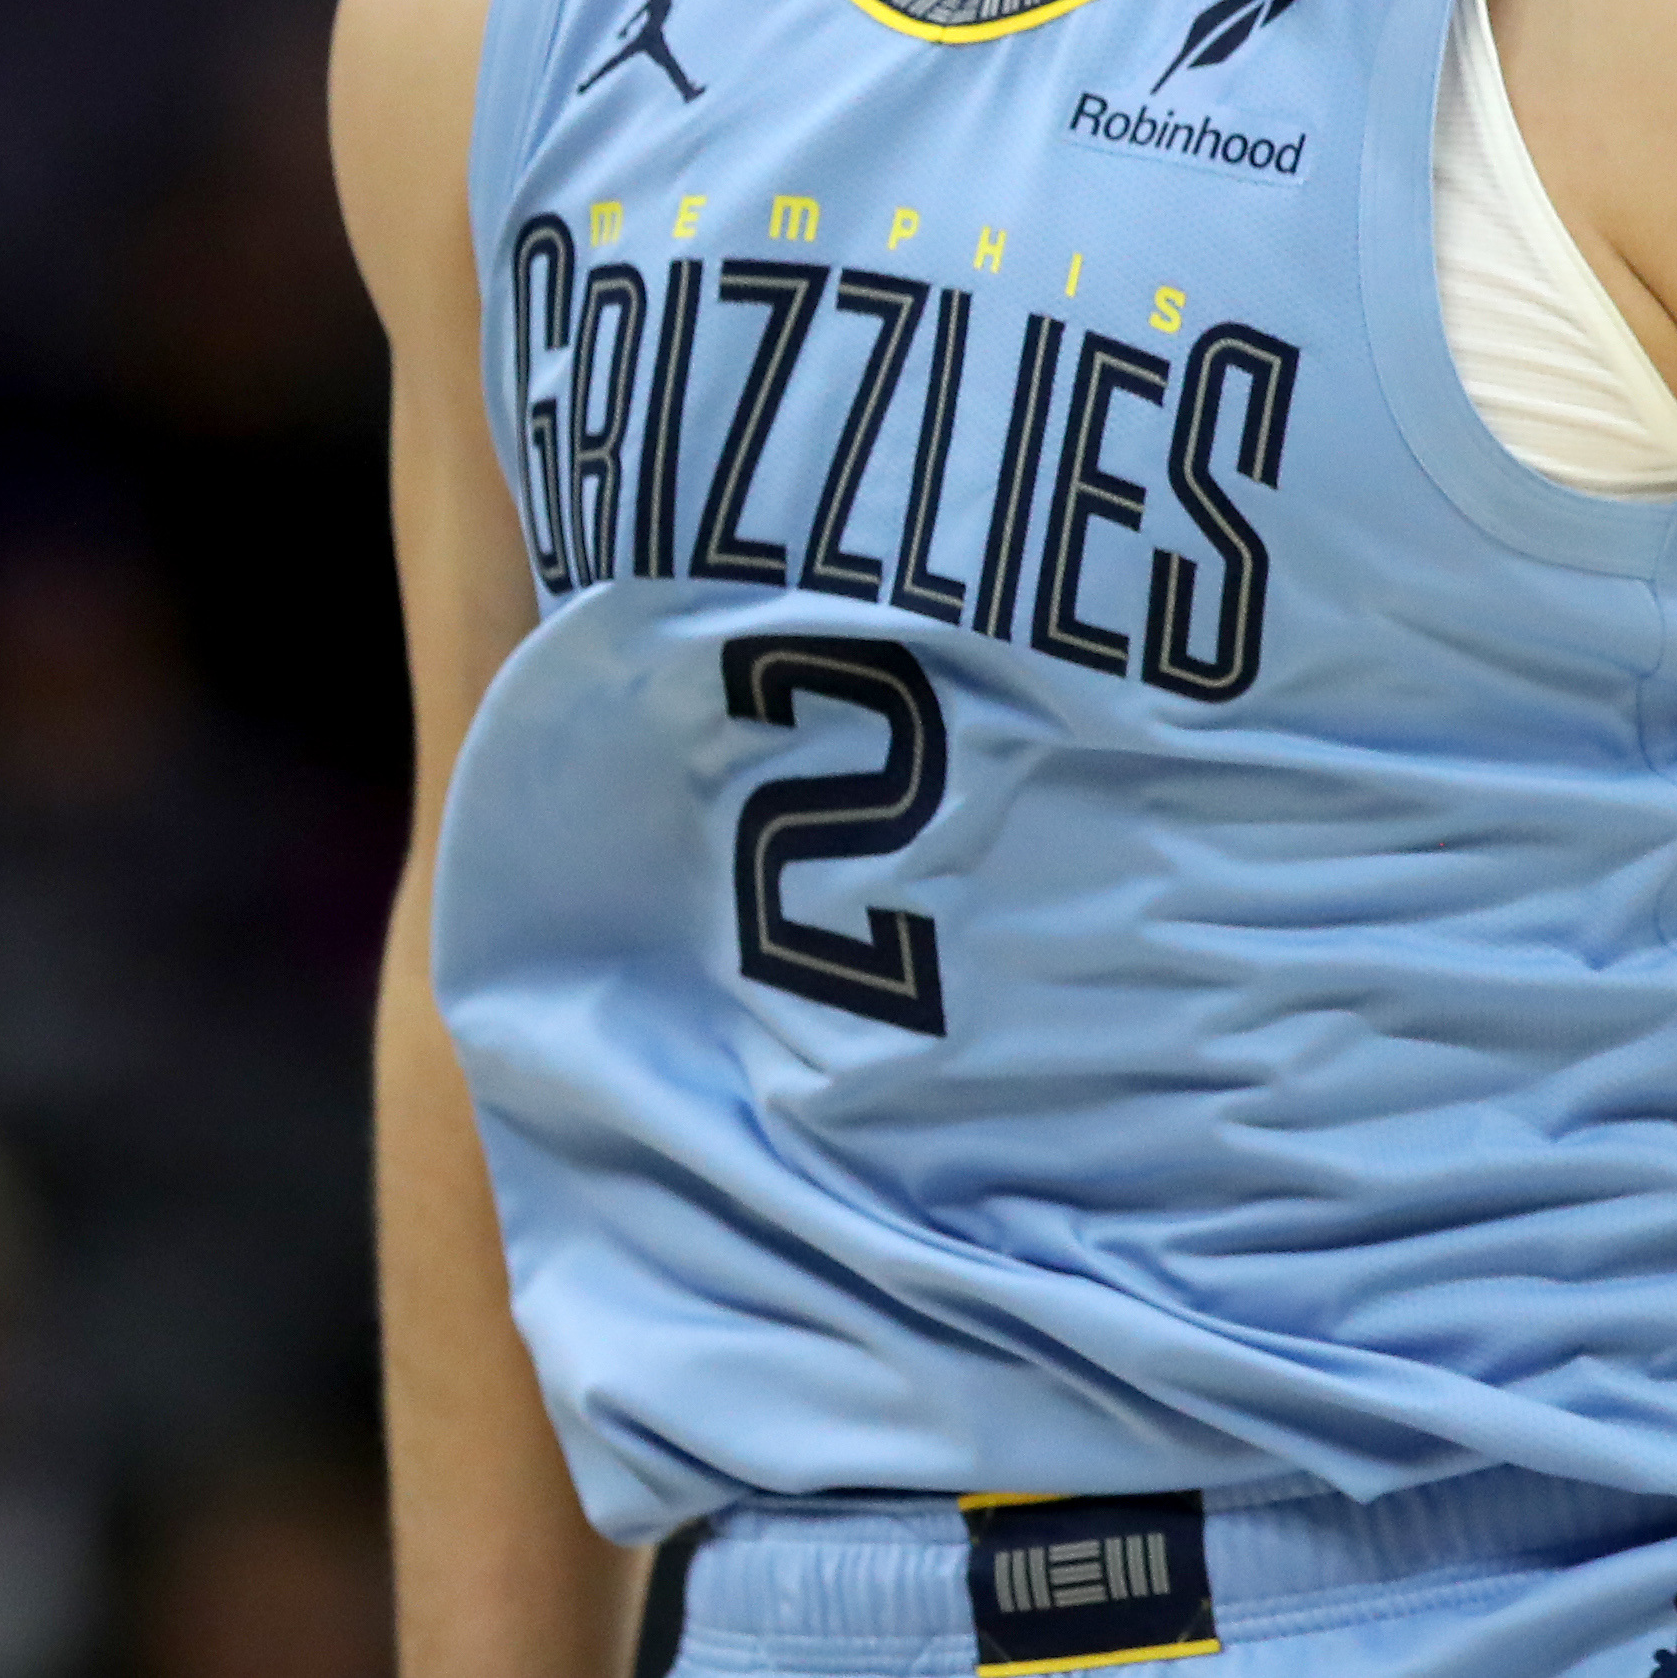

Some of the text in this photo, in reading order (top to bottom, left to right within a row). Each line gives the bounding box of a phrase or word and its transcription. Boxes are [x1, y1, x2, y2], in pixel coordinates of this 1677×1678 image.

[590, 195, 1185, 333] MEMPHIS
[1069, 93, 1307, 176] Robinhood
[513, 212, 1301, 703] GRIZZLIES
[722, 634, 948, 1037] 2
